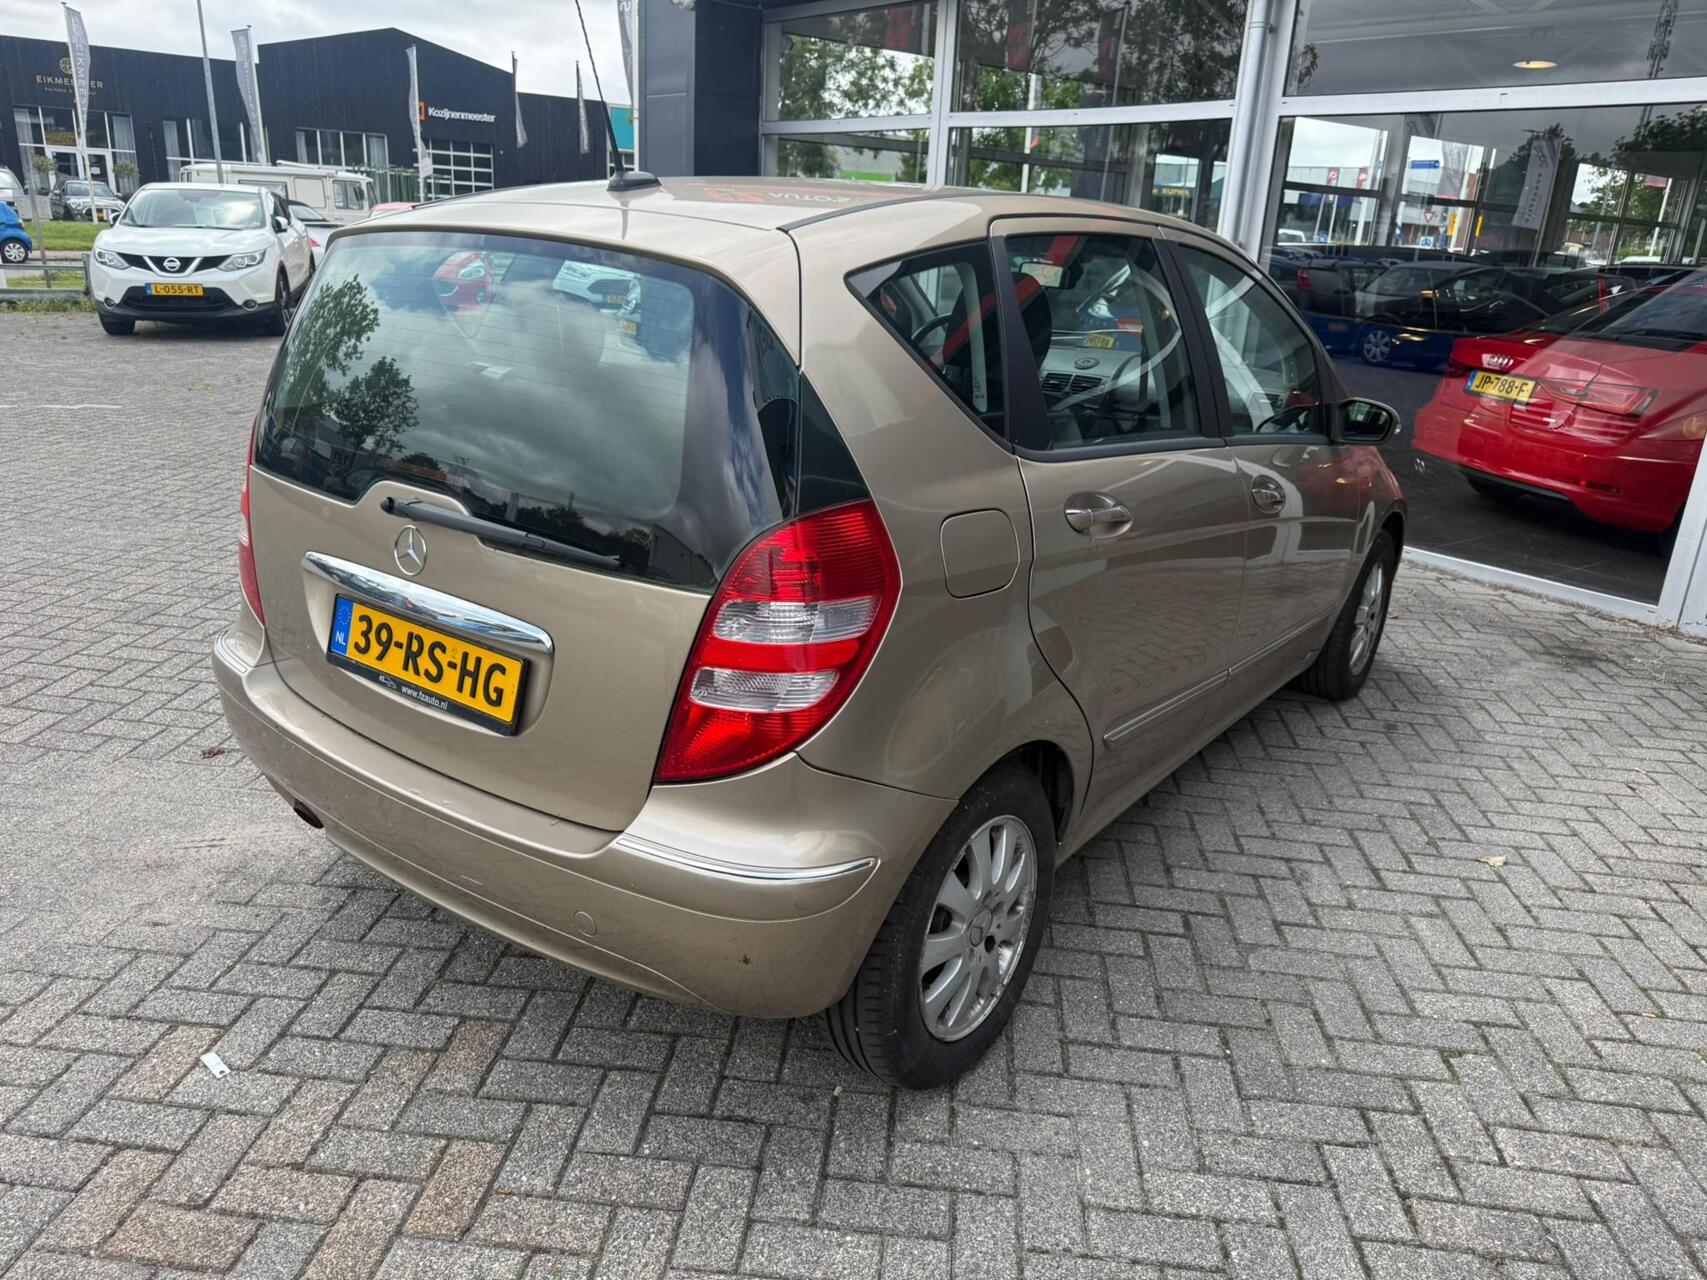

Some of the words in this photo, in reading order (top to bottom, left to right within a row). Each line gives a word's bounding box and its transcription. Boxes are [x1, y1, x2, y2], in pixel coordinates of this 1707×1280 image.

[428, 107, 496, 122] Kozijnenmeester
[154, 285, 199, 294] L-055-RT
[1475, 375, 1528, 396] JP-788-F
[335, 631, 346, 646] NL
[354, 615, 506, 708] 39-RS-HG
[401, 685, 448, 710] www.fzauto.nl
